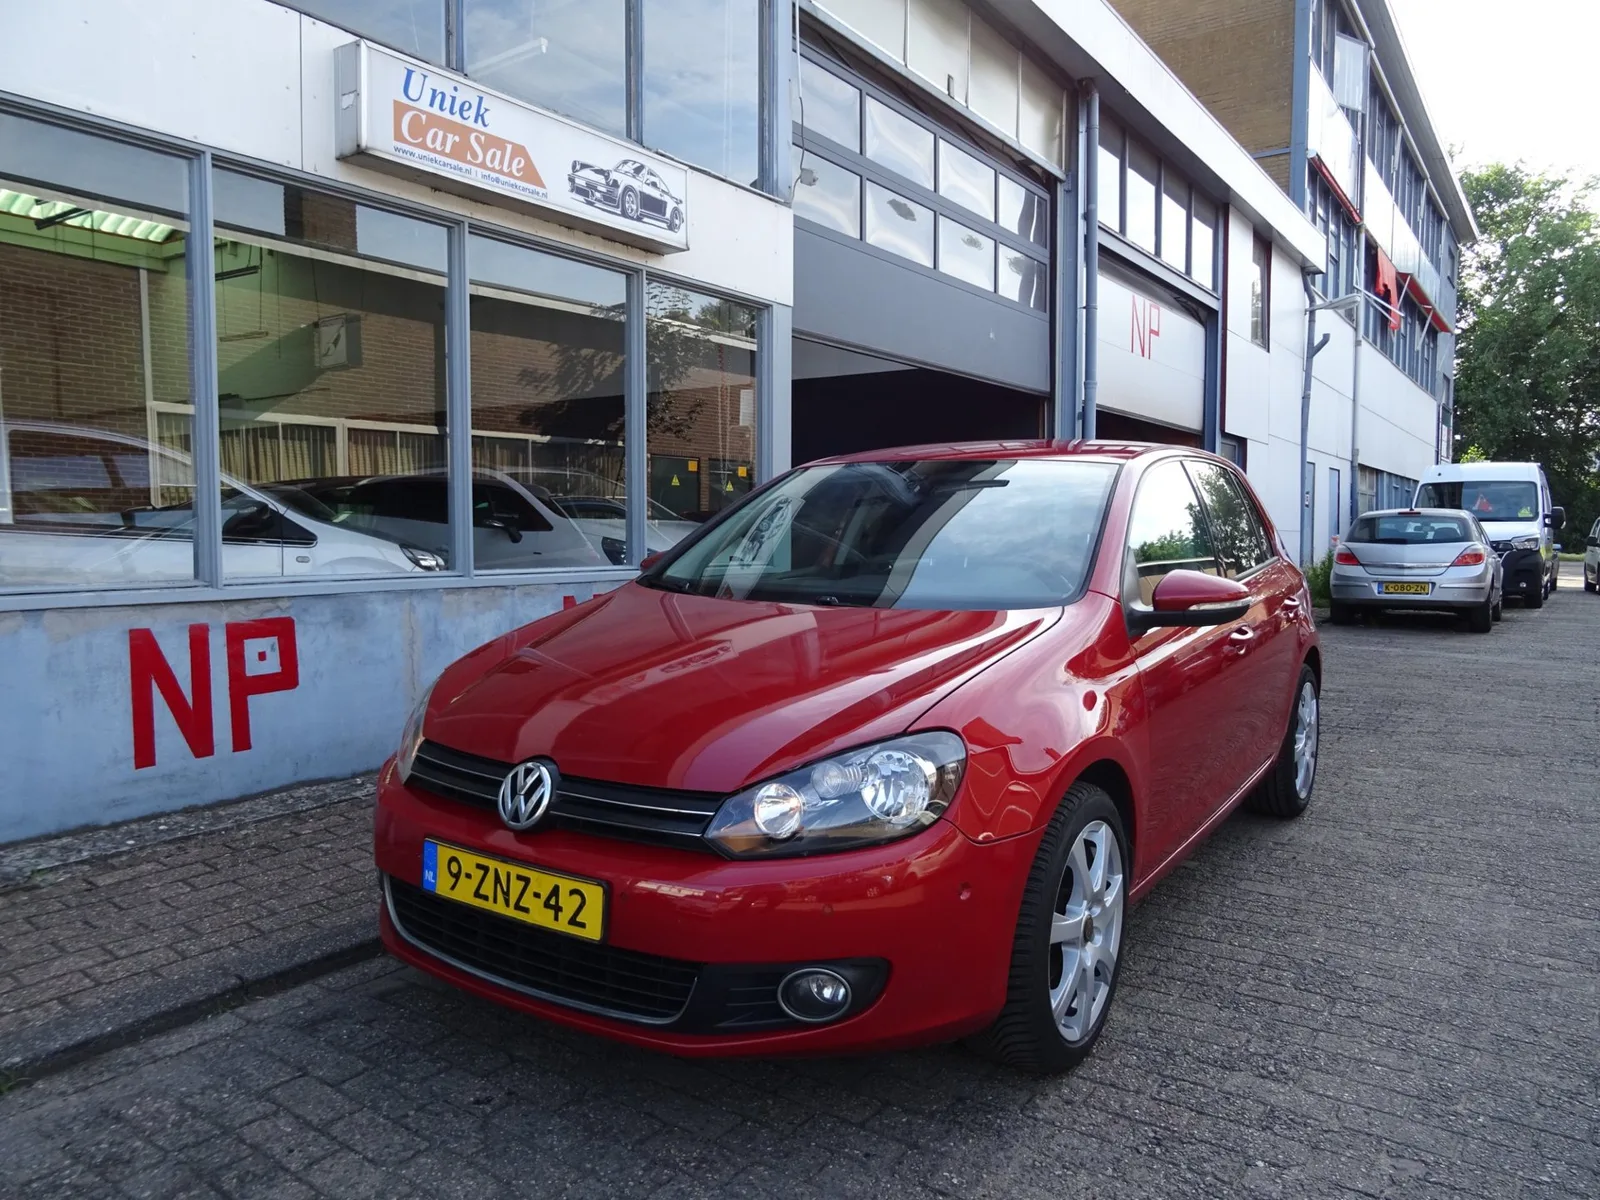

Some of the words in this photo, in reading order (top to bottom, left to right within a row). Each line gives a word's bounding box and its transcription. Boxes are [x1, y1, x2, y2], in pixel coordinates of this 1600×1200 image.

[402, 67, 490, 128] Uniek
[393, 145, 472, 176] www.uniekcarsale.nl
[480, 171, 548, 199] info@uniekcarsale.nl
[401, 110, 460, 154] Car
[467, 132, 525, 177] Sale
[1131, 294, 1160, 360] NP
[129, 616, 299, 770] NP
[424, 869, 436, 883] NL
[447, 855, 587, 929] 9-ZNZ-42
